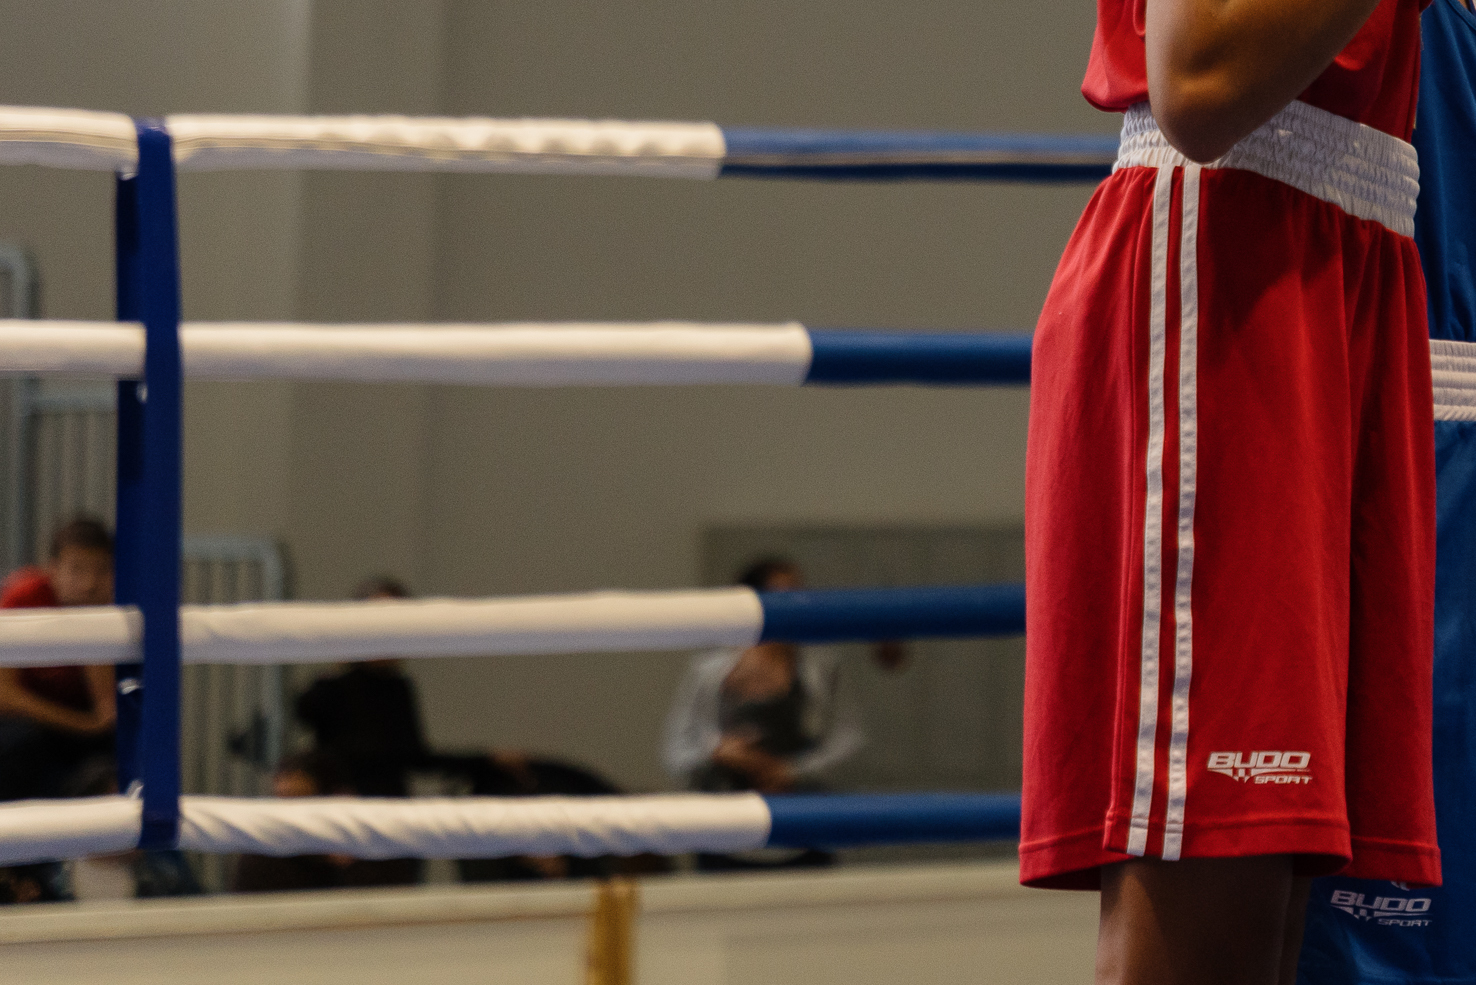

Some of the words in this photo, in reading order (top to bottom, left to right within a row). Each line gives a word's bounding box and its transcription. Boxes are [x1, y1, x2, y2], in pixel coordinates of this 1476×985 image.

[1207, 750, 1311, 769] BUDO
[1254, 775, 1313, 785] SPORT
[1330, 889, 1432, 912] BUDO
[1377, 918, 1432, 927] SPORT
